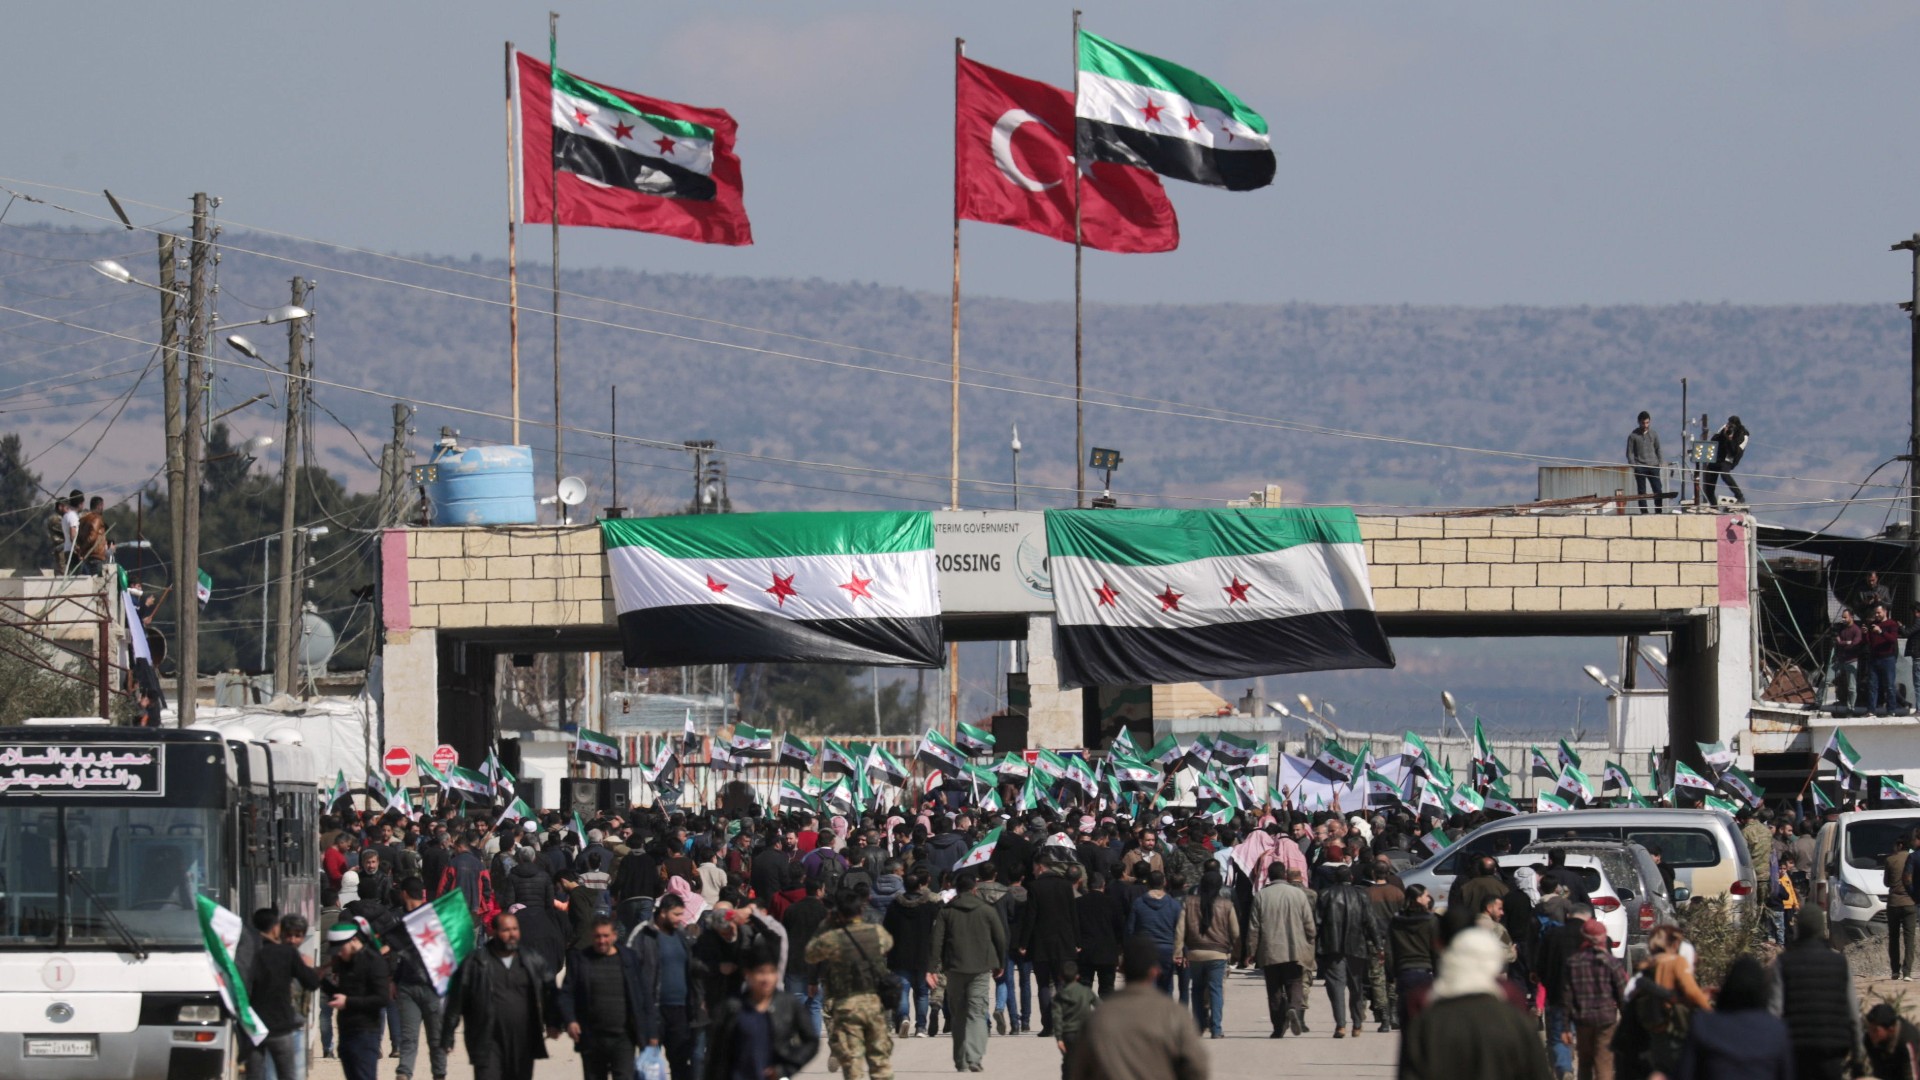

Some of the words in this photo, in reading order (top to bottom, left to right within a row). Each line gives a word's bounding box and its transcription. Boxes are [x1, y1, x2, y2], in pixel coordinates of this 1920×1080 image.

[933, 523, 961, 533] NTERIM
[963, 523, 1019, 533] GOVERNMENT
[935, 554, 1000, 572] ROSSING
[60, 746, 96, 770] باب
[93, 750, 153, 770] معبر
[55, 965, 62, 982] 1
